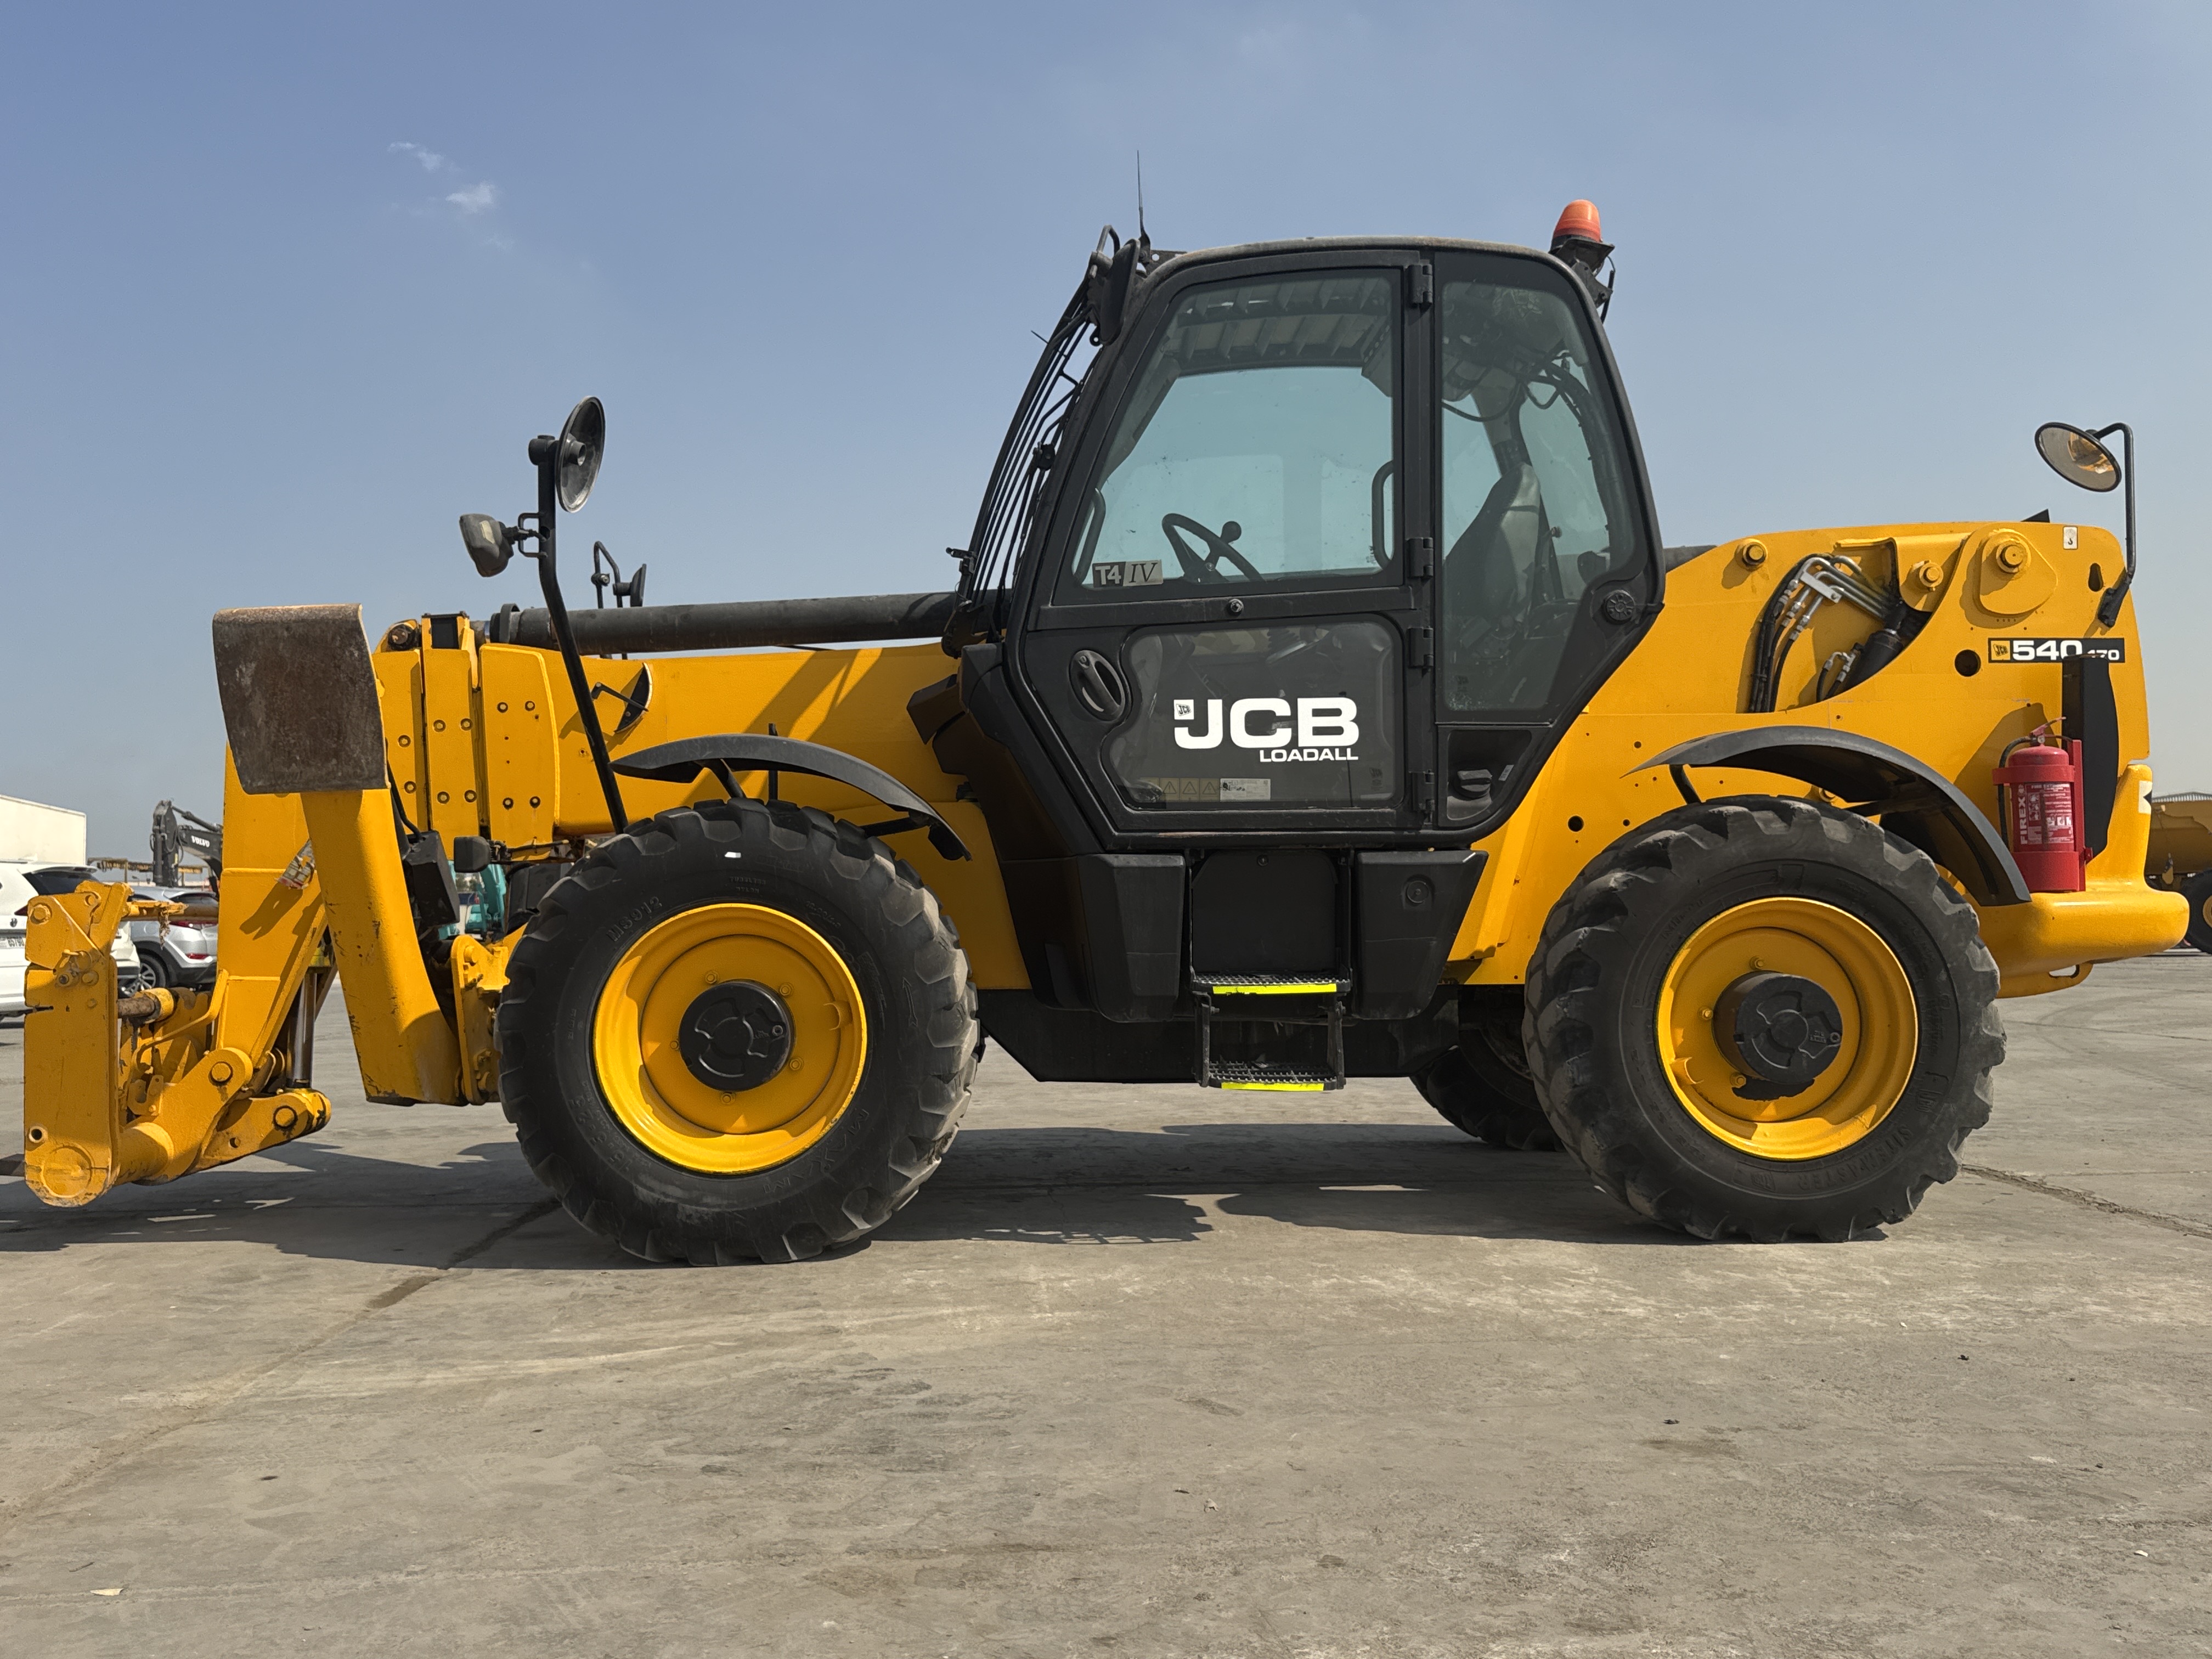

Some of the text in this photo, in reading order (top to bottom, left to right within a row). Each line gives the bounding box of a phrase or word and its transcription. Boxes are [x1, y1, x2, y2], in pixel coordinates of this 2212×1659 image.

[1095, 562, 1158, 585] T4 IV
[1995, 645, 2008, 656] JCB
[2012, 640, 2083, 661] 540
[1178, 705, 1190, 715] JCB
[1174, 697, 1359, 749] JCB
[1260, 747, 1358, 762] LOADALL
[2018, 797, 2028, 845] FIREX
[191, 835, 210, 848] VOLVO
[606, 896, 663, 942] MS912
[762, 1108, 870, 1194] MAXAM
